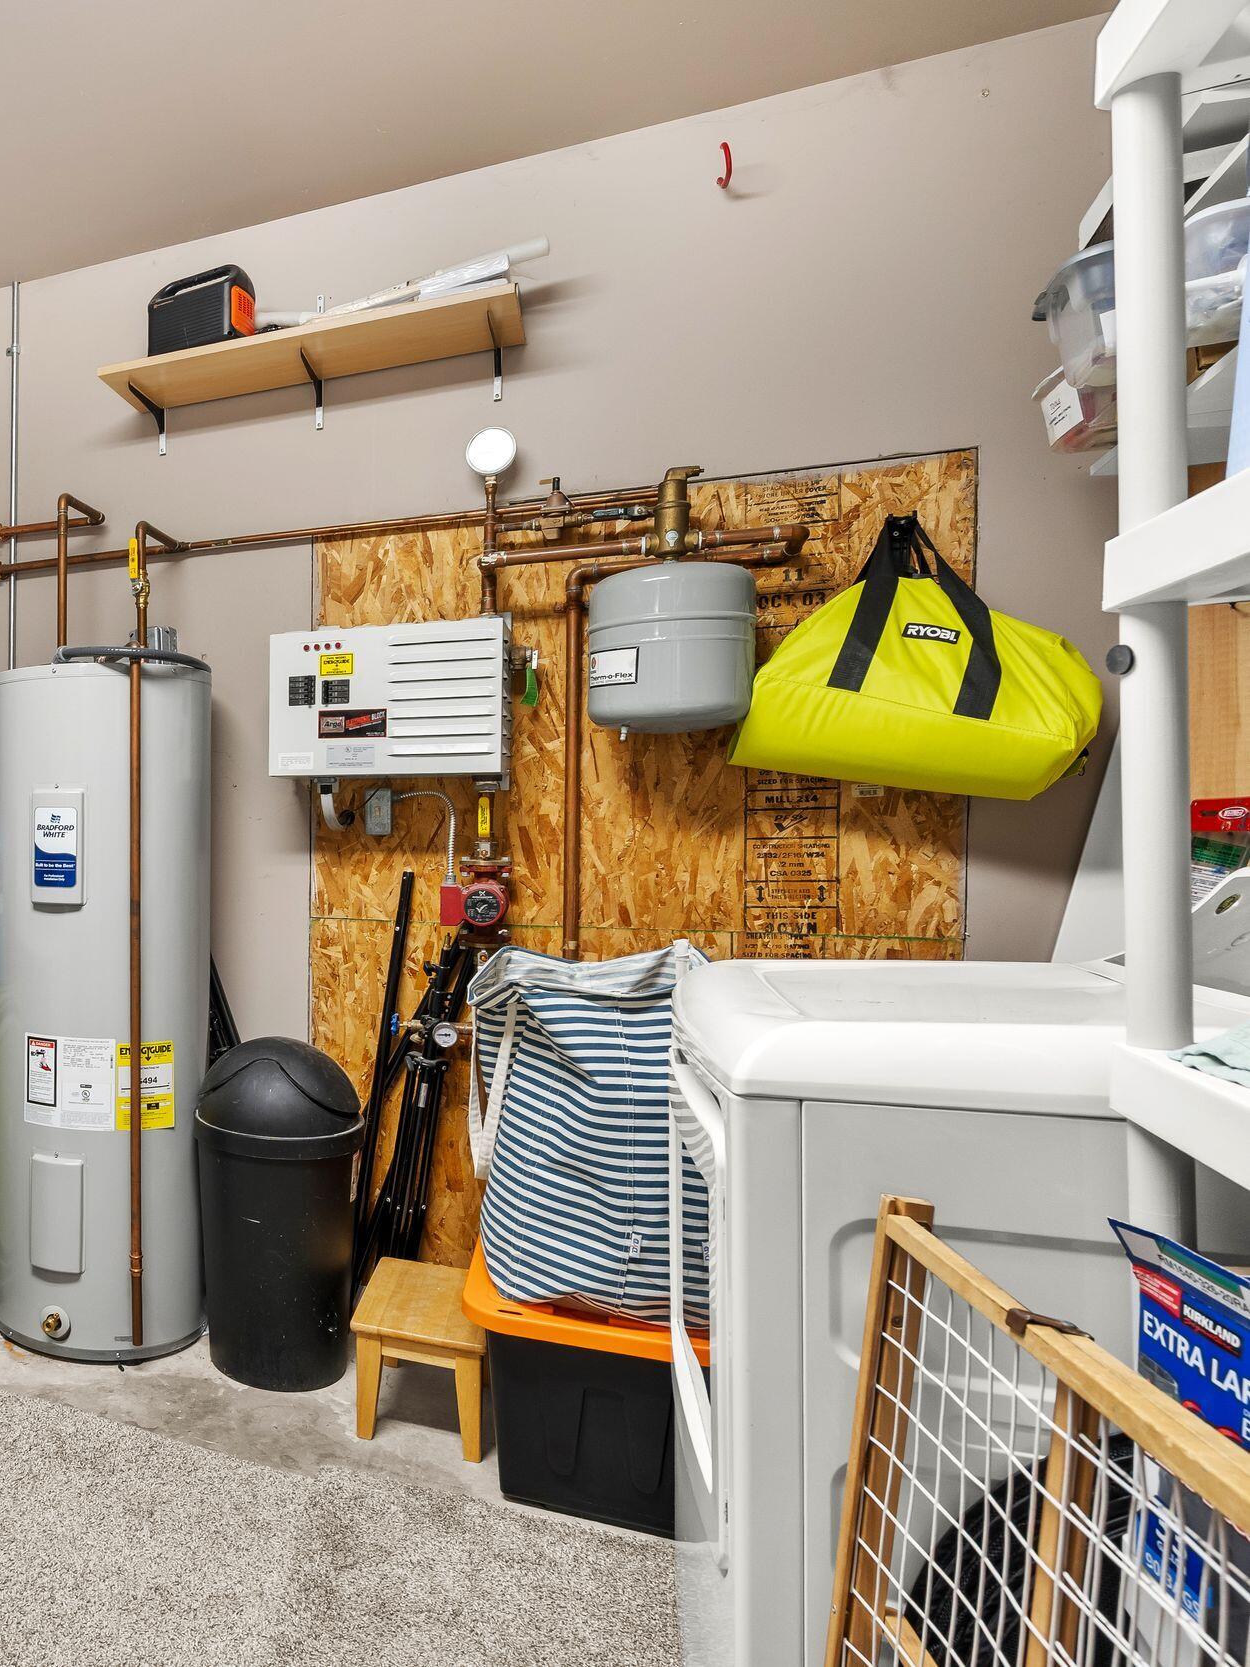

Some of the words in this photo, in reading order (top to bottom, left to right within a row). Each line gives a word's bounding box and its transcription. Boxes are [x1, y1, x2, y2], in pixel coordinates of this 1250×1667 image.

[758, 593, 795, 610] OCT
[802, 591, 827, 606] 03
[324, 719, 342, 729] Argo
[765, 795, 792, 804] MILL
[36, 823, 75, 832] BRADFORD
[765, 911, 789, 920] THIS
[793, 911, 818, 920] SIDE
[1182, 1303, 1241, 1348] KIRKLAND
[1143, 1309, 1206, 1377] EXTRA
